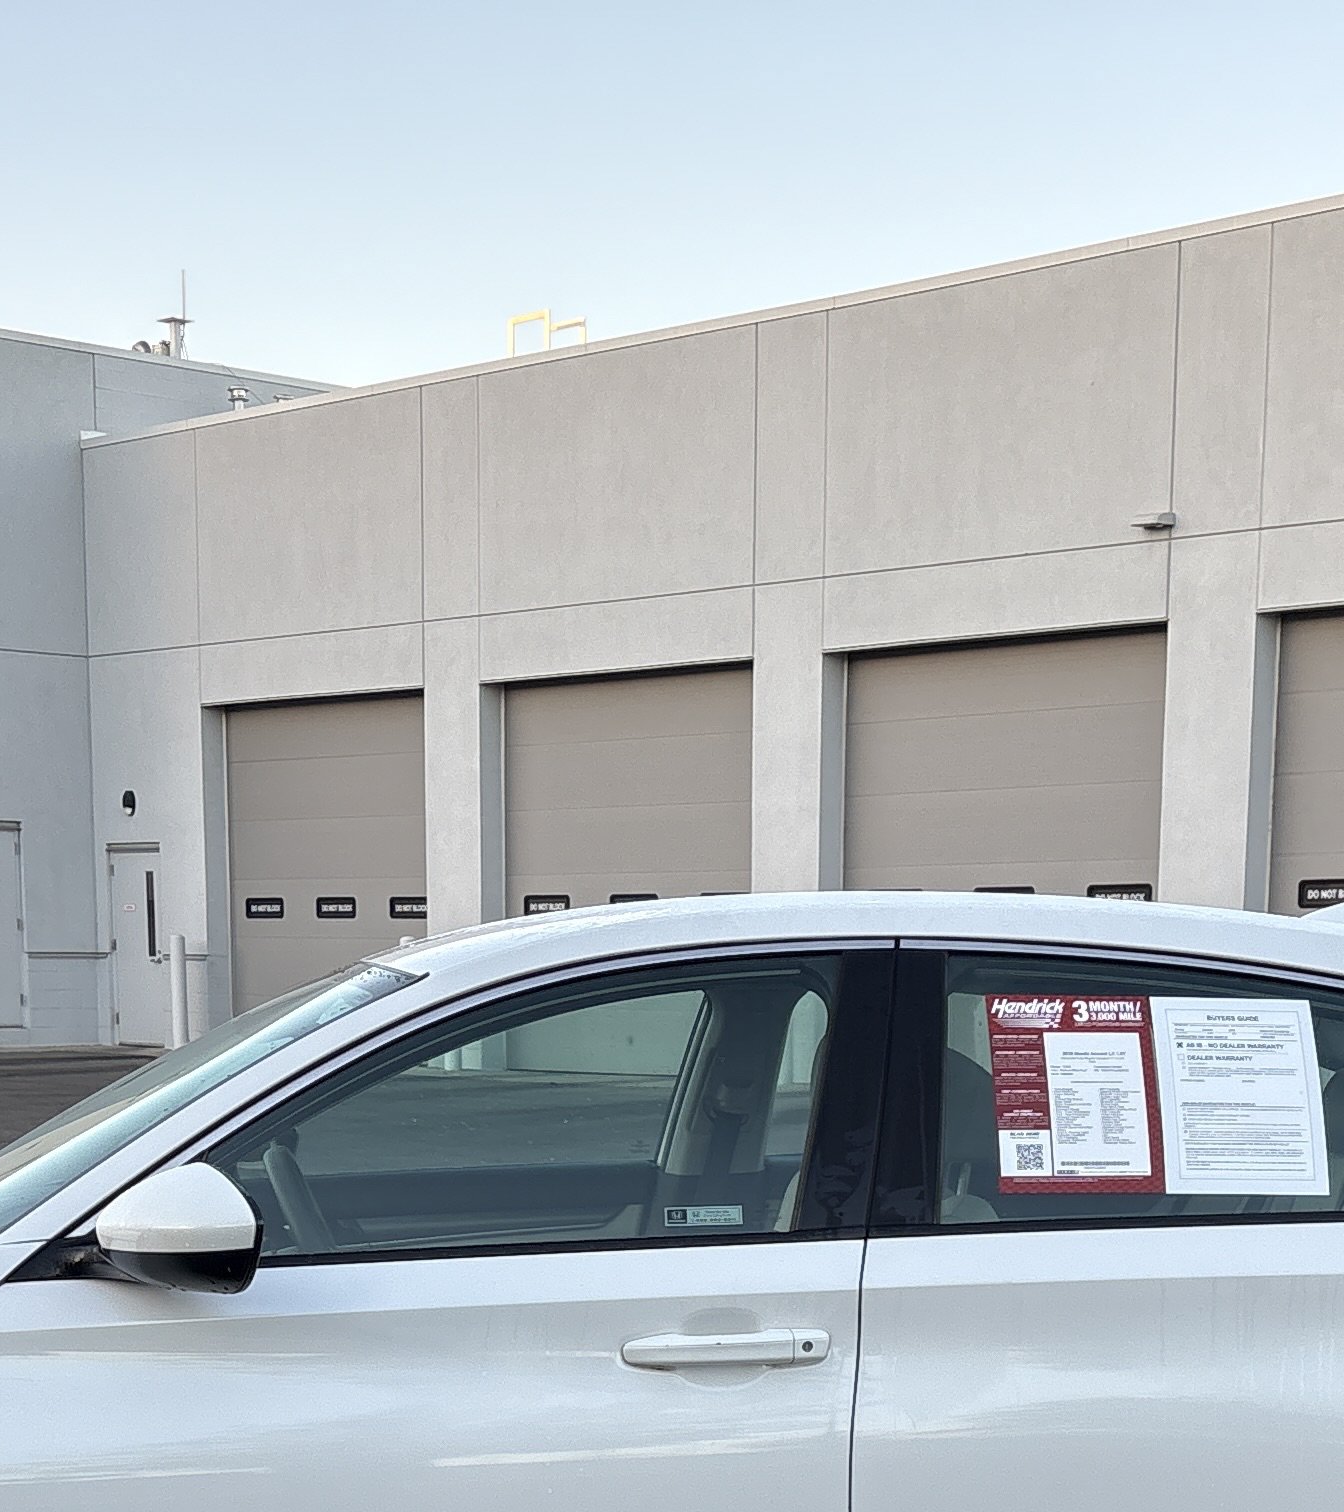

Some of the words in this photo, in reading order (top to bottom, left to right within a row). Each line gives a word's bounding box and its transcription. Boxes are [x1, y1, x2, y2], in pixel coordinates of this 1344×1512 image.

[1307, 889, 1320, 899] DO
[1321, 889, 1337, 899] NOT
[991, 998, 1066, 1018] Hendrick
[1071, 1000, 1089, 1022] 3
[1089, 1001, 1141, 1012] MONTH/
[1118, 1012, 1142, 1021] MILE
